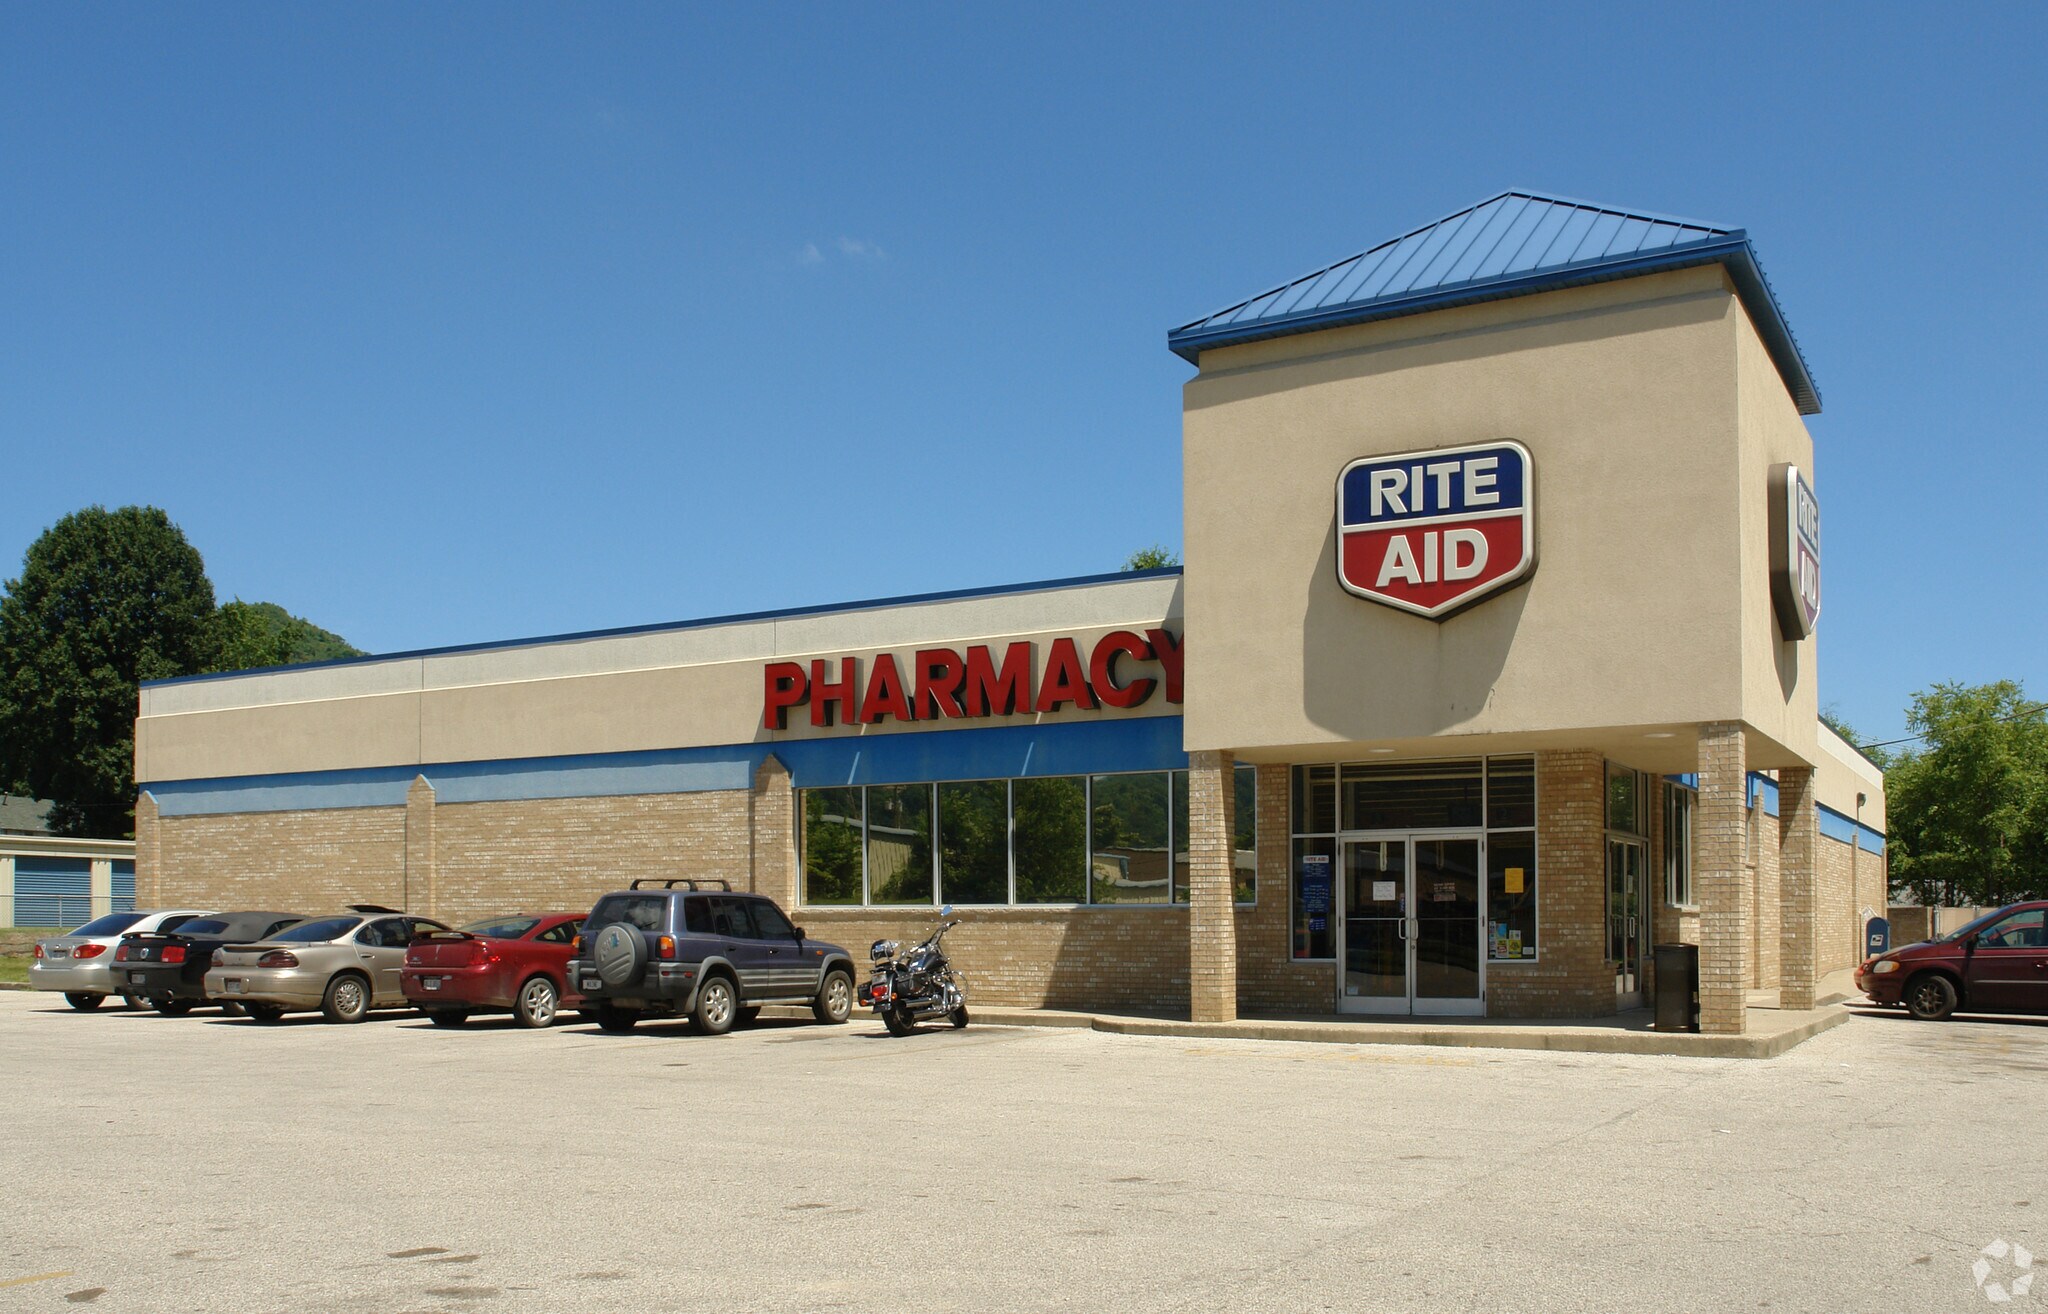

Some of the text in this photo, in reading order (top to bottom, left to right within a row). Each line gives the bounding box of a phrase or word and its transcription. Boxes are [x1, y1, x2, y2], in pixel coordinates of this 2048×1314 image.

[1370, 457, 1499, 517] RITE
[1375, 528, 1489, 588] AID
[764, 628, 1185, 731] PHARMACY
